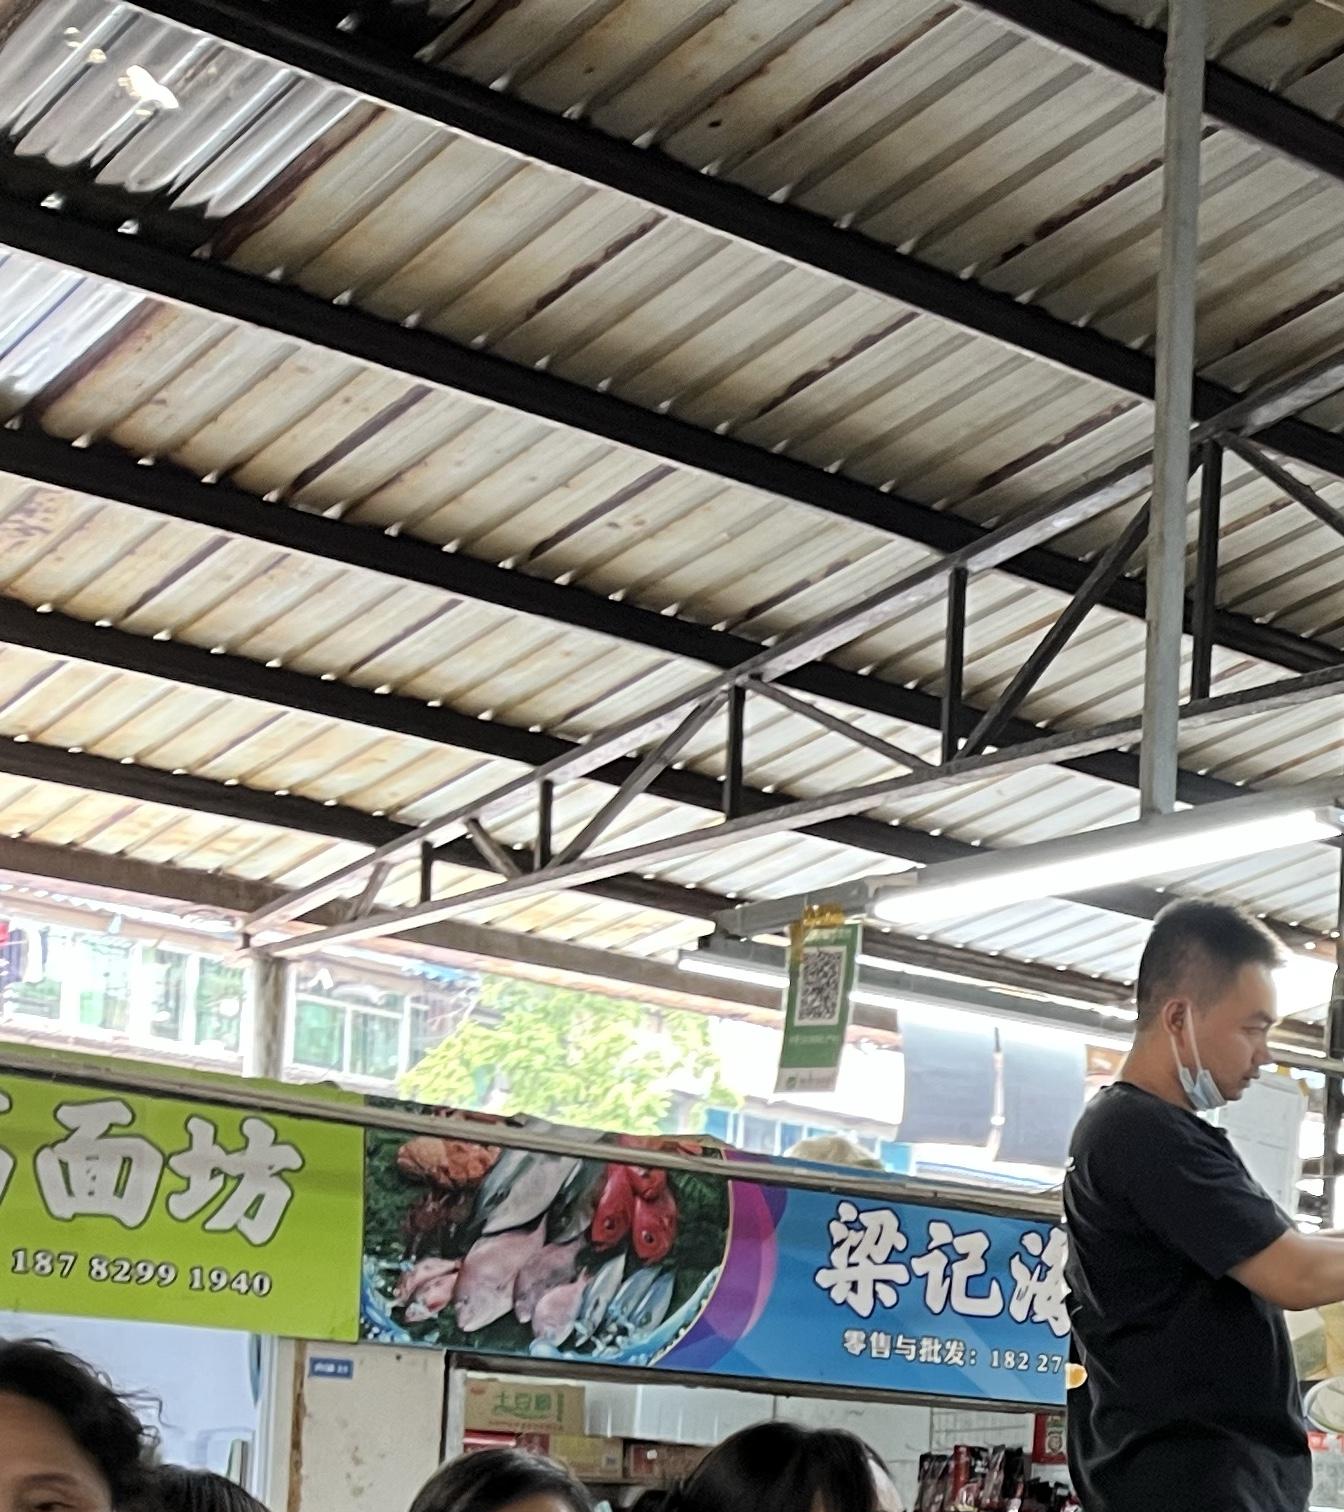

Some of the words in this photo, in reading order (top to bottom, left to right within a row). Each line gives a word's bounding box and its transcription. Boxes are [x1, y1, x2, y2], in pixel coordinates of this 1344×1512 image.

[0, 1089, 305, 1247] 面坊
[11, 1249, 78, 1277] 187
[88, 1256, 177, 1287] 8299
[189, 1267, 273, 1297] 1940
[990, 1349, 1029, 1371] 182
